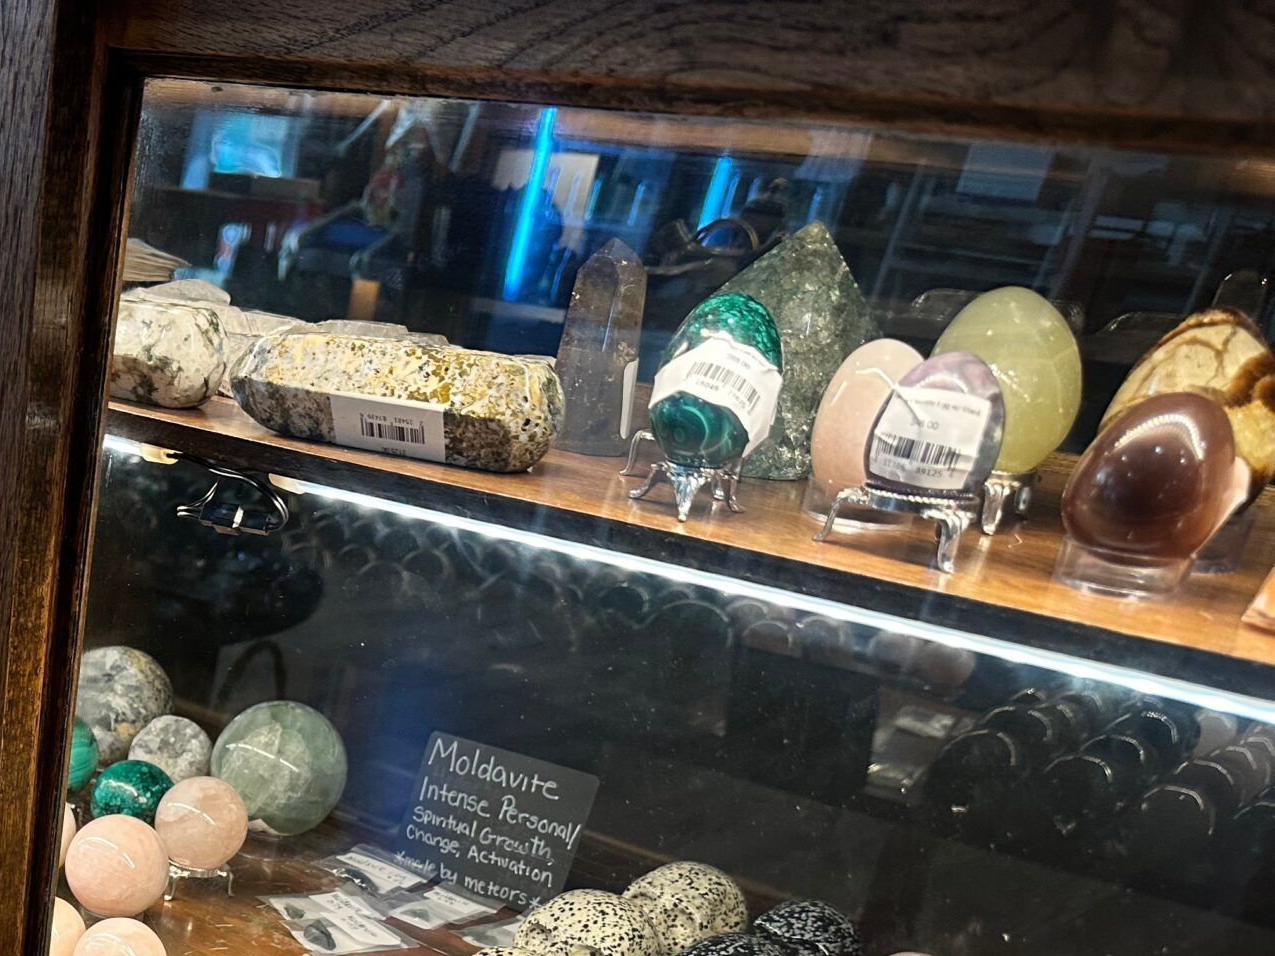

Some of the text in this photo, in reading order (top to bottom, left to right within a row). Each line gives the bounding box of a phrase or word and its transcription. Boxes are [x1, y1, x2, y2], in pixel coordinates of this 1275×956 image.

[427, 737, 560, 801] Moldavite
[419, 776, 491, 818] Intense
[412, 805, 477, 839] Spiritual
[440, 862, 458, 885] by
[467, 845, 554, 888] Activation
